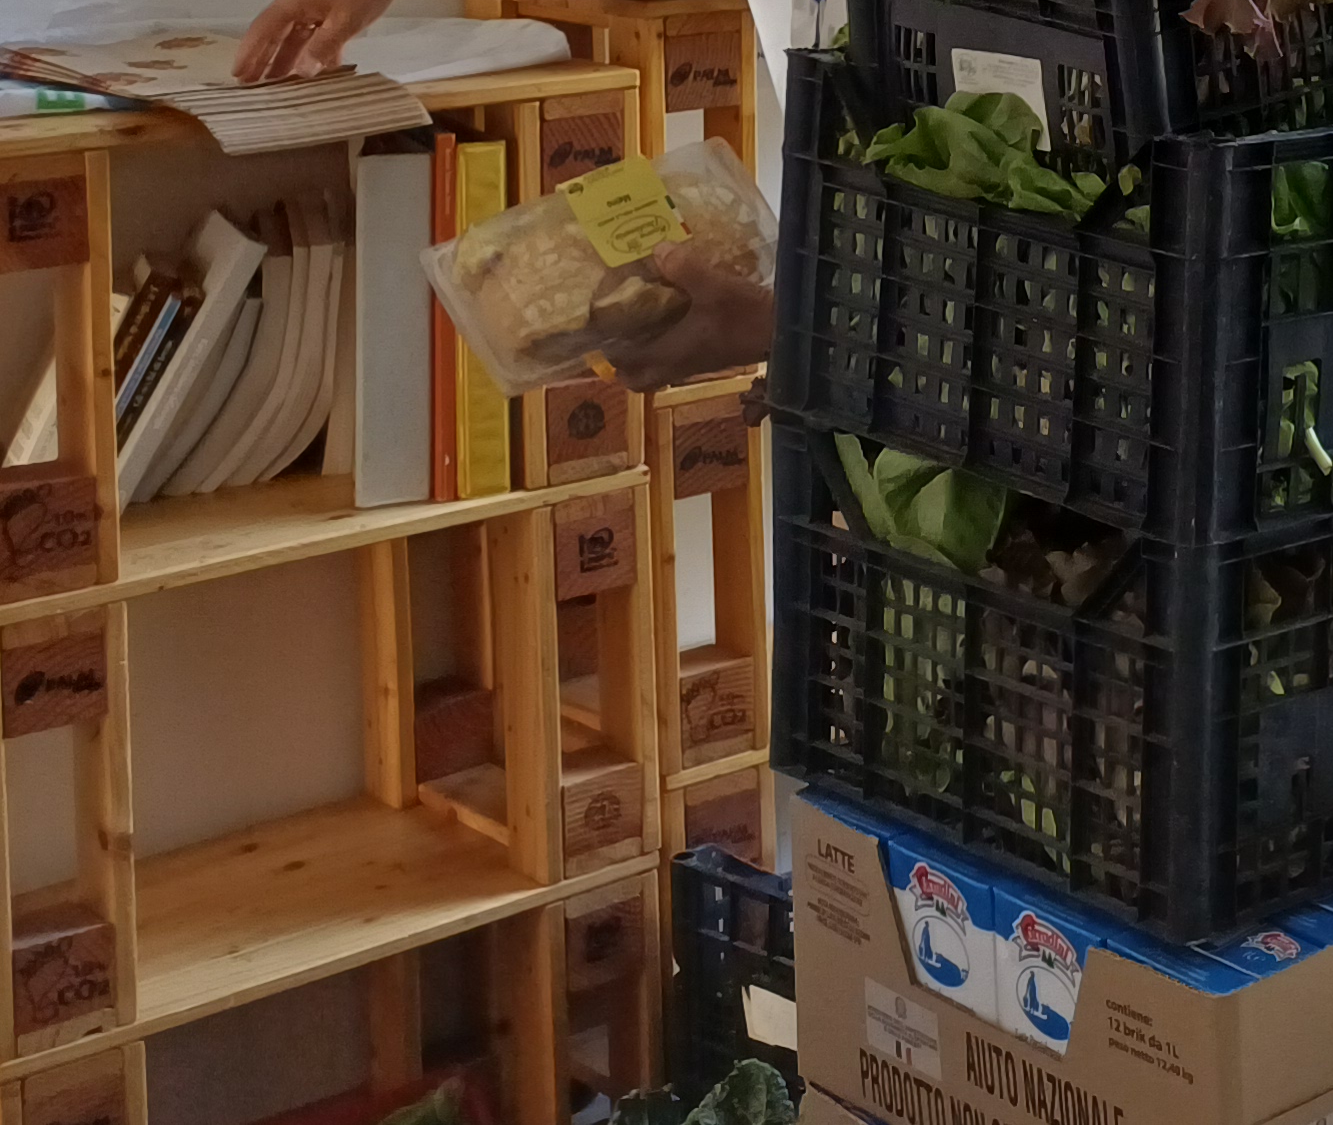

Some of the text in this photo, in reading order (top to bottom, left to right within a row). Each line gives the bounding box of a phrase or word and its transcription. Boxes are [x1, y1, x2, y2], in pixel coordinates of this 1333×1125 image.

[817, 838, 856, 875] LATTE
[1105, 997, 1153, 1027] contiene:
[1106, 1015, 1181, 1060] 12 brik da 1L
[1108, 1036, 1131, 1055] peso
[1130, 1045, 1155, 1065] netto
[859, 1047, 946, 1125] PRODOTTO
[965, 1031, 1019, 1108] AIUTO
